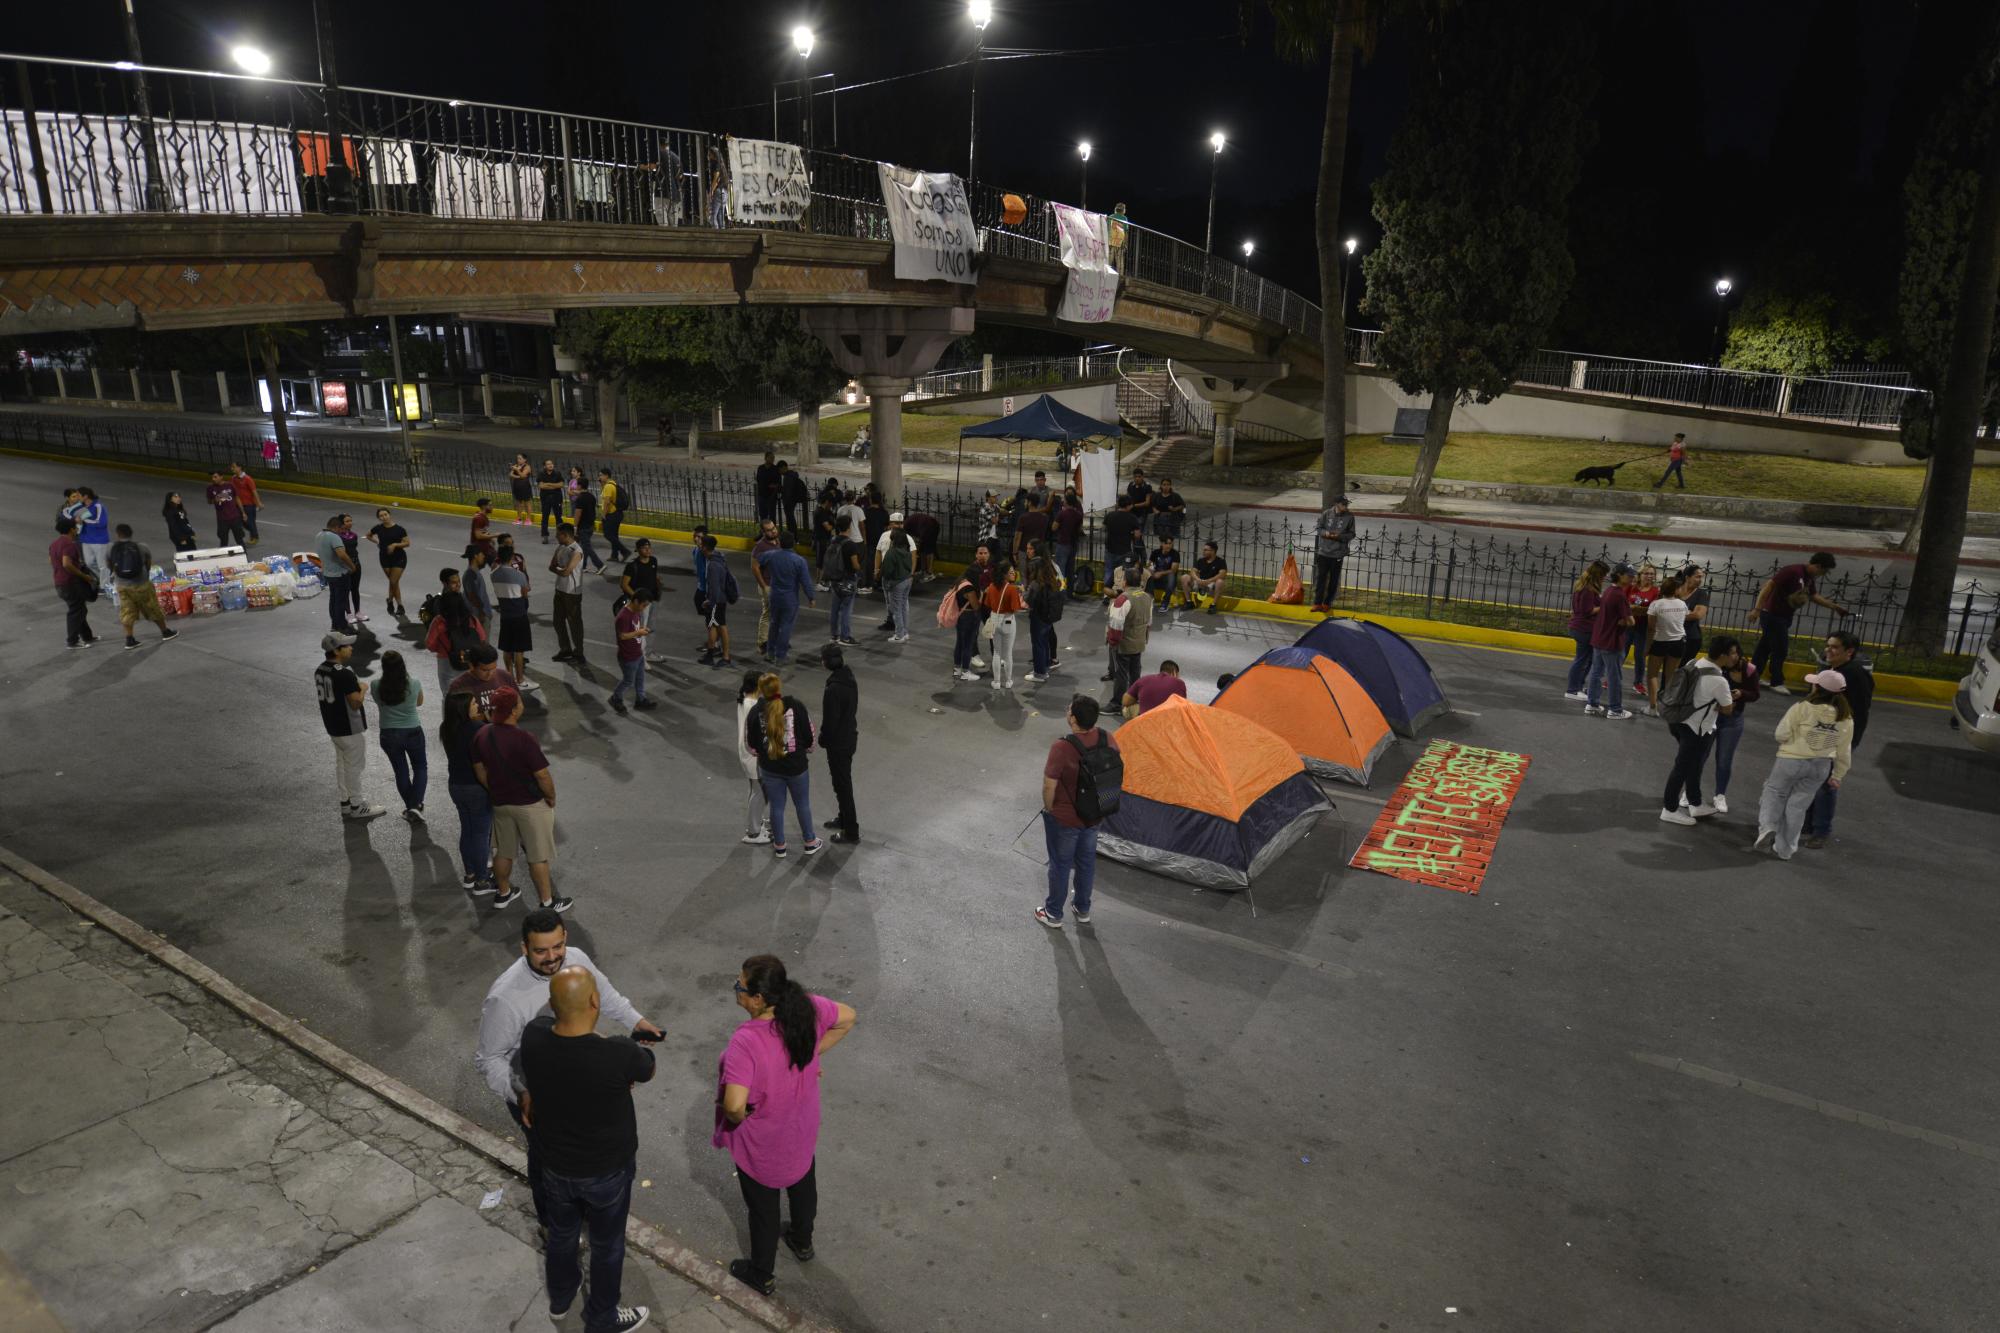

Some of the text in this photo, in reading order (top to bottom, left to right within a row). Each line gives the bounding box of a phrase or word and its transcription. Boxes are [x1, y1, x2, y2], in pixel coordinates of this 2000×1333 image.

[764, 145, 787, 168] TEC
[742, 173, 760, 193] ES
[936, 249, 966, 277] UNO
[315, 674, 336, 704] 60
